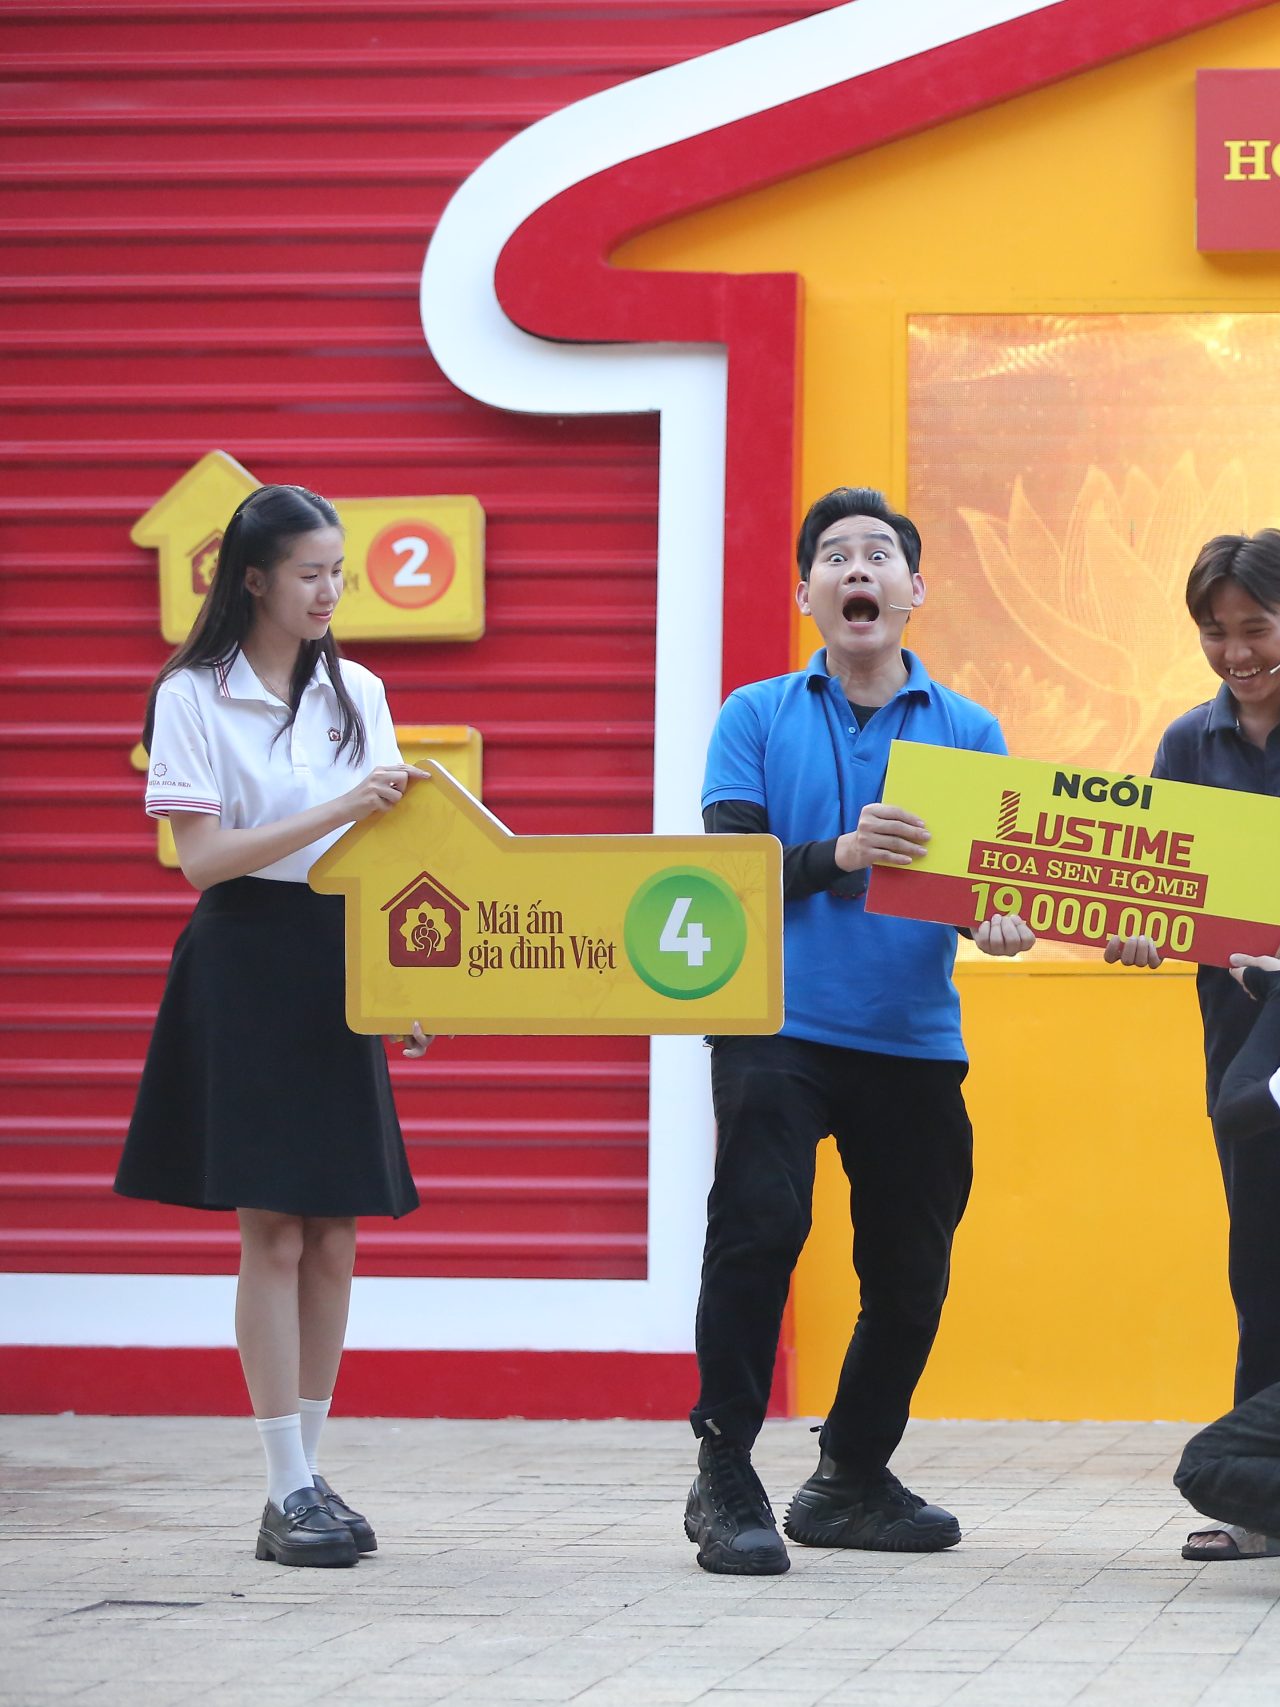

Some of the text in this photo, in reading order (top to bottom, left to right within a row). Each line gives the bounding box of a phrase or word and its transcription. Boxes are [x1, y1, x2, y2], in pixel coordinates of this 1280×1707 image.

[391, 535, 432, 587] 2
[1052, 771, 1153, 810] NGÓI
[995, 789, 1195, 868] LUSTIME
[979, 849, 1199, 900] HOA SEN HOME
[476, 899, 564, 935] Mái ấm
[659, 897, 711, 966] 4
[468, 935, 617, 978] gia đình Việt
